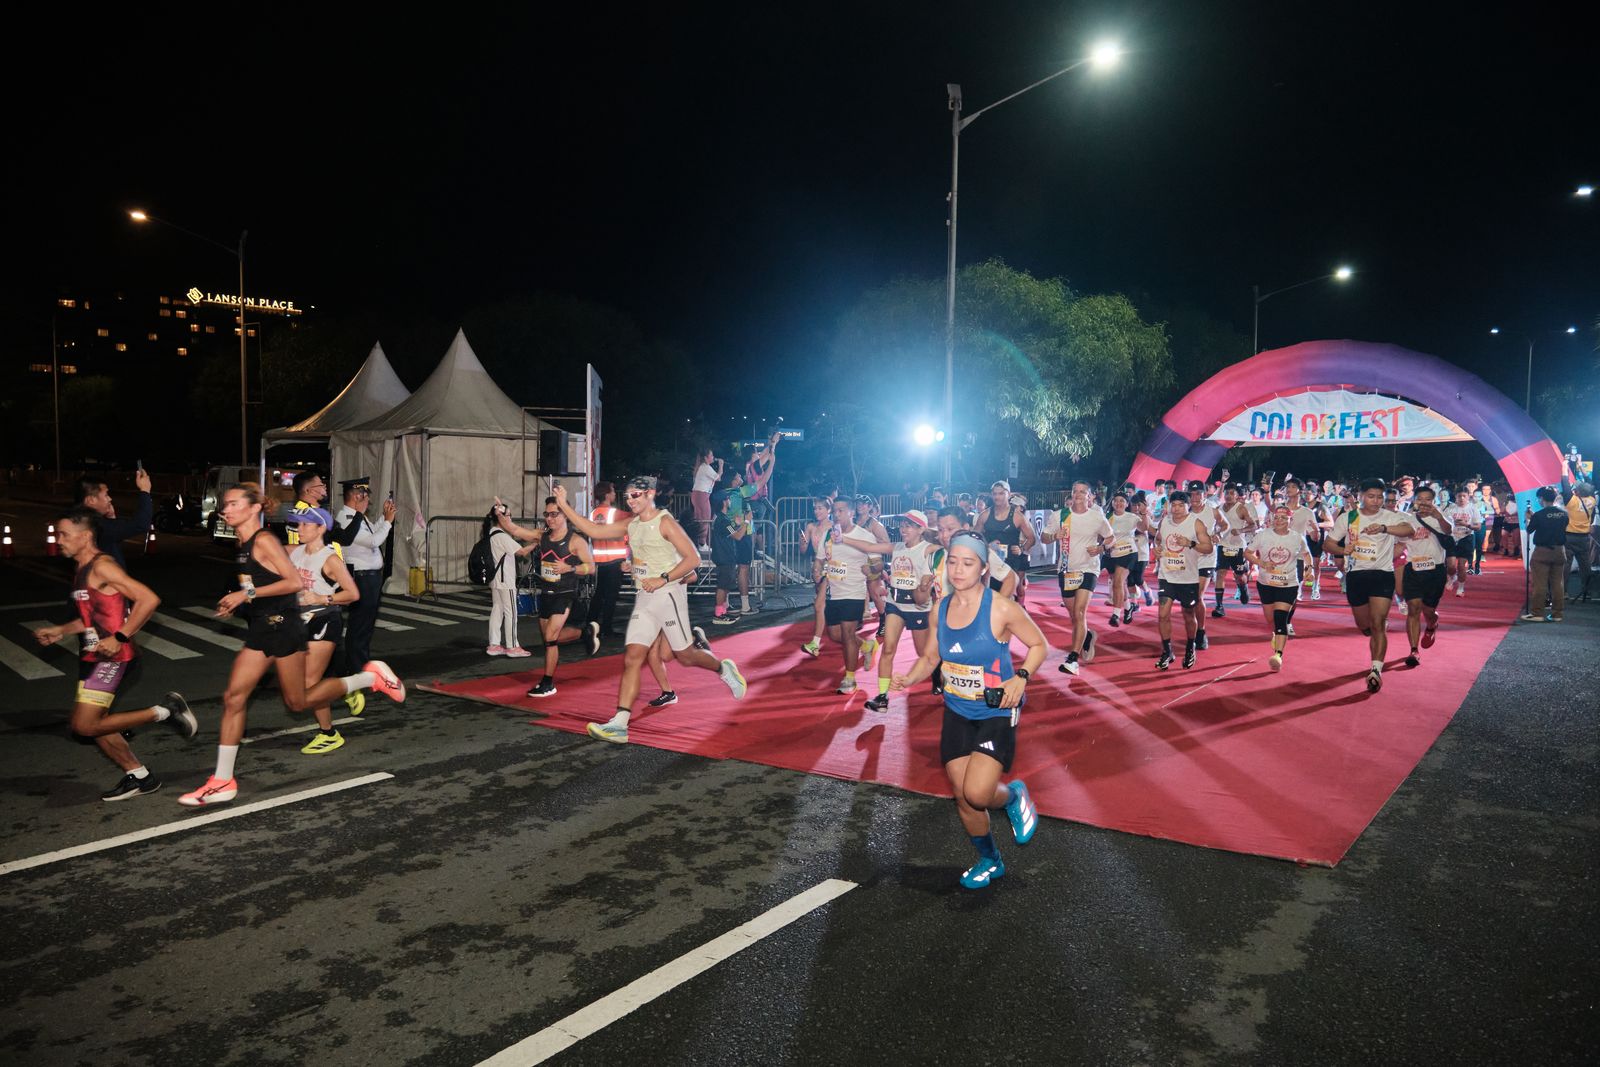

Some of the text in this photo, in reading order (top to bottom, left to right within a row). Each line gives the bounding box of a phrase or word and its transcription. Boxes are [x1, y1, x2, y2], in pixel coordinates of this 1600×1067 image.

[206, 292, 294, 310] LANSON PLACE
[1250, 406, 1405, 440] COLORFEST
[896, 578, 915, 587] 21102
[950, 675, 982, 689] 21375
